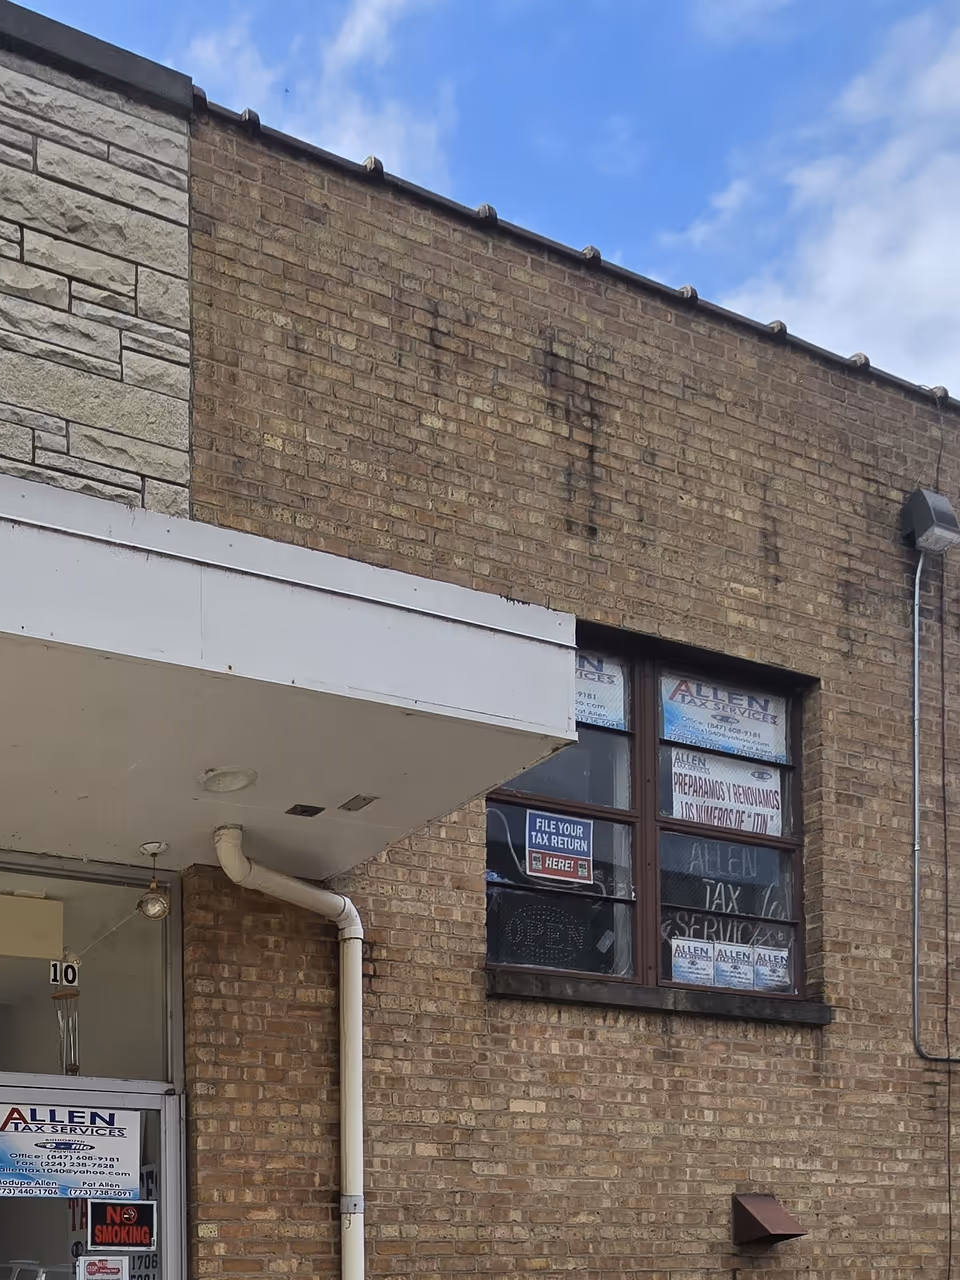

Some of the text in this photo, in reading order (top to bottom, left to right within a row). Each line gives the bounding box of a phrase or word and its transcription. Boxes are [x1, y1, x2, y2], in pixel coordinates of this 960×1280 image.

[669, 680, 770, 713] ALLEN
[679, 693, 779, 725] TAX SERVICES
[674, 752, 706, 767] ALLEN
[674, 772, 780, 810] PREPARAMOS Y RENOVAMOS
[536, 818, 584, 837] FILE YOUR
[531, 832, 588, 851] TAX RETURN
[545, 857, 574, 872] HERE!
[690, 842, 758, 877] ALLEN
[702, 879, 742, 915] TAX
[505, 918, 584, 951] OPEN
[674, 944, 709, 957] ALLEN
[716, 949, 751, 962] ALLEN
[755, 953, 788, 965] ALLEN
[52, 963, 77, 985] 10
[10, 1121, 126, 1137] TAX SERVICES
[69, 1161, 115, 1169] 238-7528
[75, 1154, 120, 1163] 608-9181
[34, 1179, 58, 1187] Allen
[99, 1181, 121, 1189] Allen
[17, 1188, 59, 1196] 440-1706
[69, 1188, 132, 1198] (773) 738-5091
[95, 1225, 150, 1244] SMOKING
